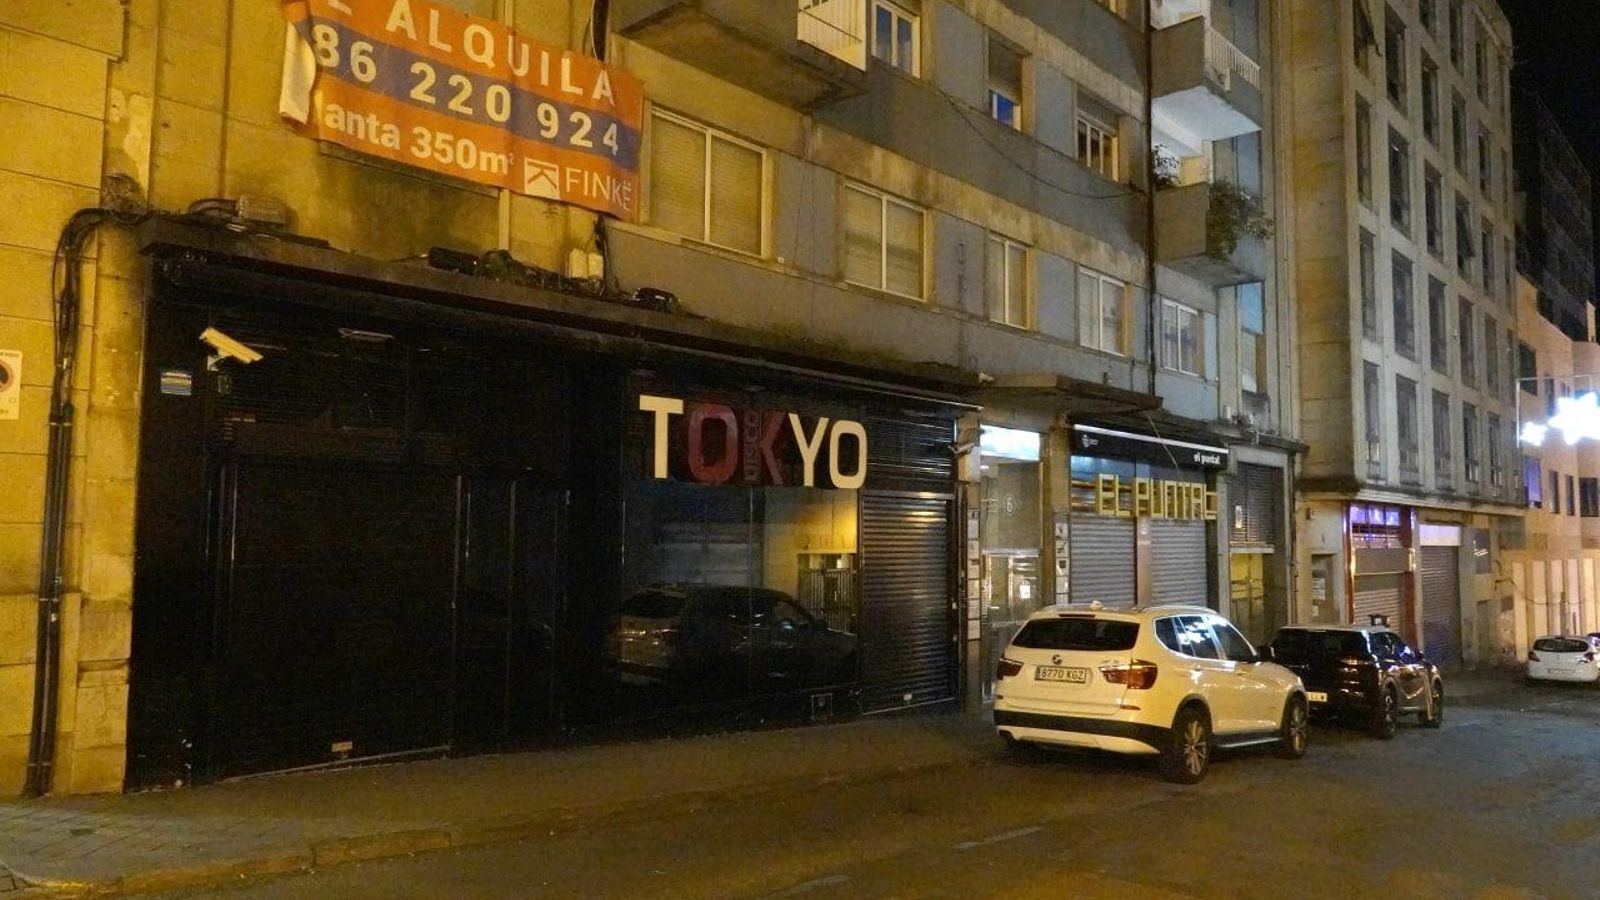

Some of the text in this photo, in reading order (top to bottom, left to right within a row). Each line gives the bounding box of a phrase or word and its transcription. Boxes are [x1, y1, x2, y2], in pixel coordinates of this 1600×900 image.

[385, 0, 614, 105] ALQUILA
[410, 61, 511, 123] 220
[536, 103, 618, 156] 924
[639, 394, 867, 489] TOKYO
[1099, 474, 1217, 520] EL PUNTAL
[1041, 667, 1064, 679] 8770
